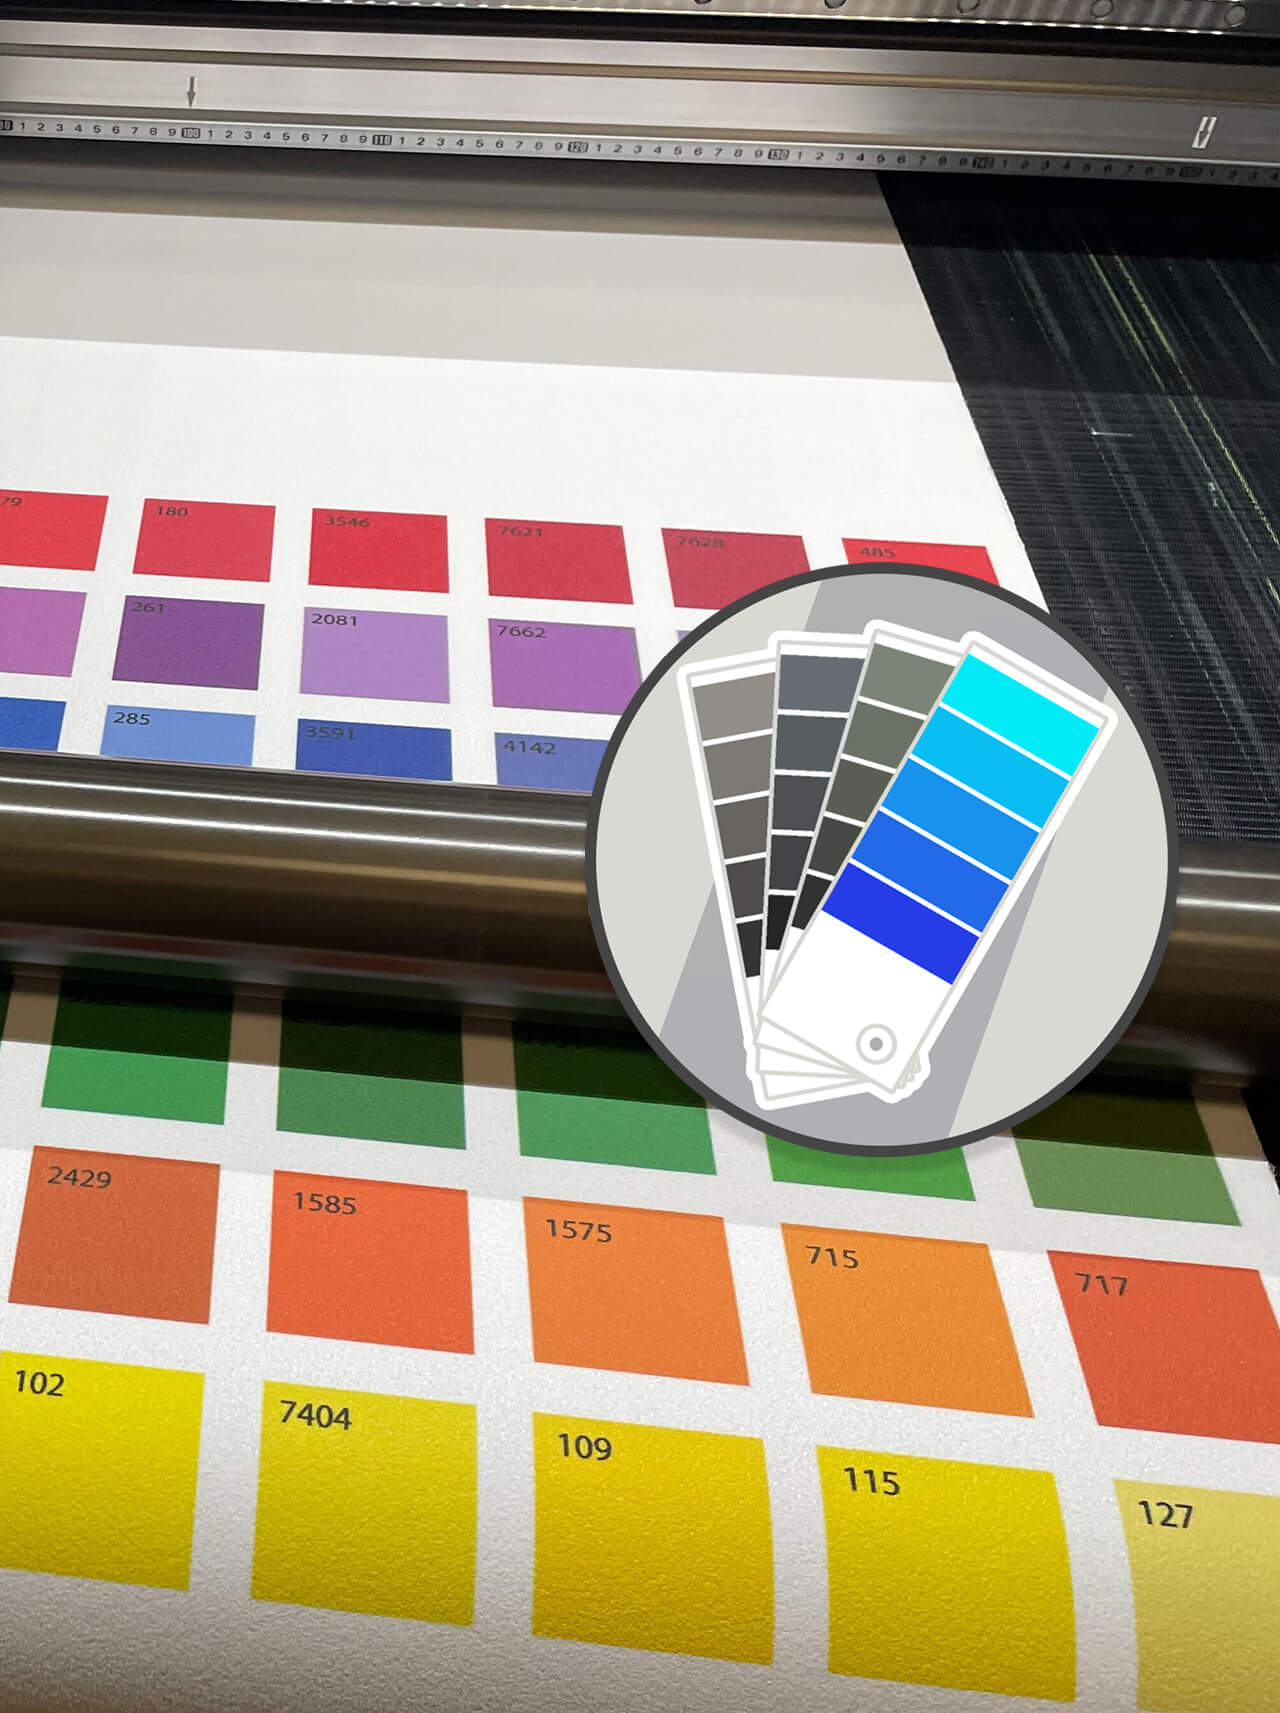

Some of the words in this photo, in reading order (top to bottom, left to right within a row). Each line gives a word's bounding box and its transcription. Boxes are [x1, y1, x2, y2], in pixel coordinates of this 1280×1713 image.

[181, 127, 201, 138] 100
[372, 135, 392, 146] 110
[158, 506, 189, 517] 180
[325, 516, 371, 528] 3546
[500, 526, 542, 537] 7621
[860, 546, 896, 558] 485
[131, 601, 164, 613] 261
[311, 613, 357, 627] 2081
[497, 624, 546, 639] 7662
[113, 711, 151, 726] 285
[307, 726, 353, 741] 3591
[503, 740, 556, 756] 4142
[47, 1166, 112, 1189] 2429
[294, 1191, 357, 1215] 1585
[546, 1219, 612, 1243] 1575
[805, 1245, 859, 1269] 715
[1074, 1272, 1128, 1297] 717
[16, 1369, 65, 1397] 102
[280, 1399, 353, 1431] 7404
[558, 1433, 612, 1461] 109
[844, 1467, 900, 1496] 115
[1138, 1500, 1193, 1529] 127
